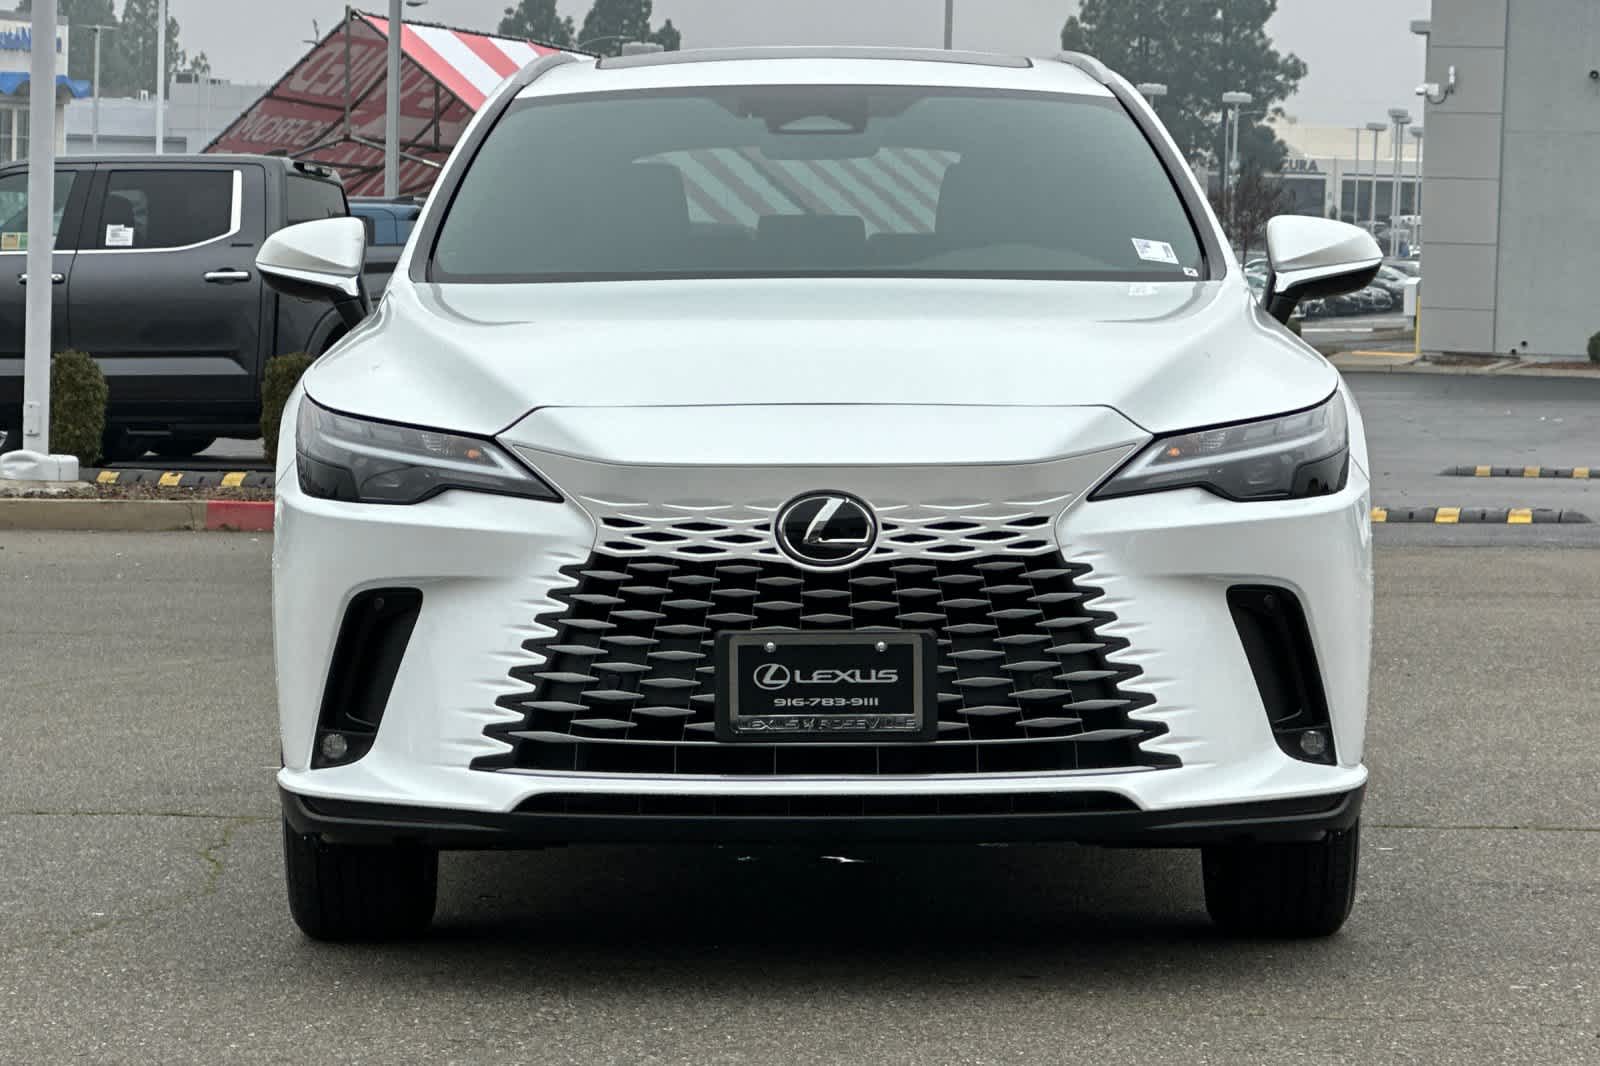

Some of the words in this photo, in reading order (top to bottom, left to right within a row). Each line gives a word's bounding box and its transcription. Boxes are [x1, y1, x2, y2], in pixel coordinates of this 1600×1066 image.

[1280, 159, 1319, 172] CURA
[794, 669, 898, 683] LEXUS
[773, 697, 879, 707] 916-783-9111
